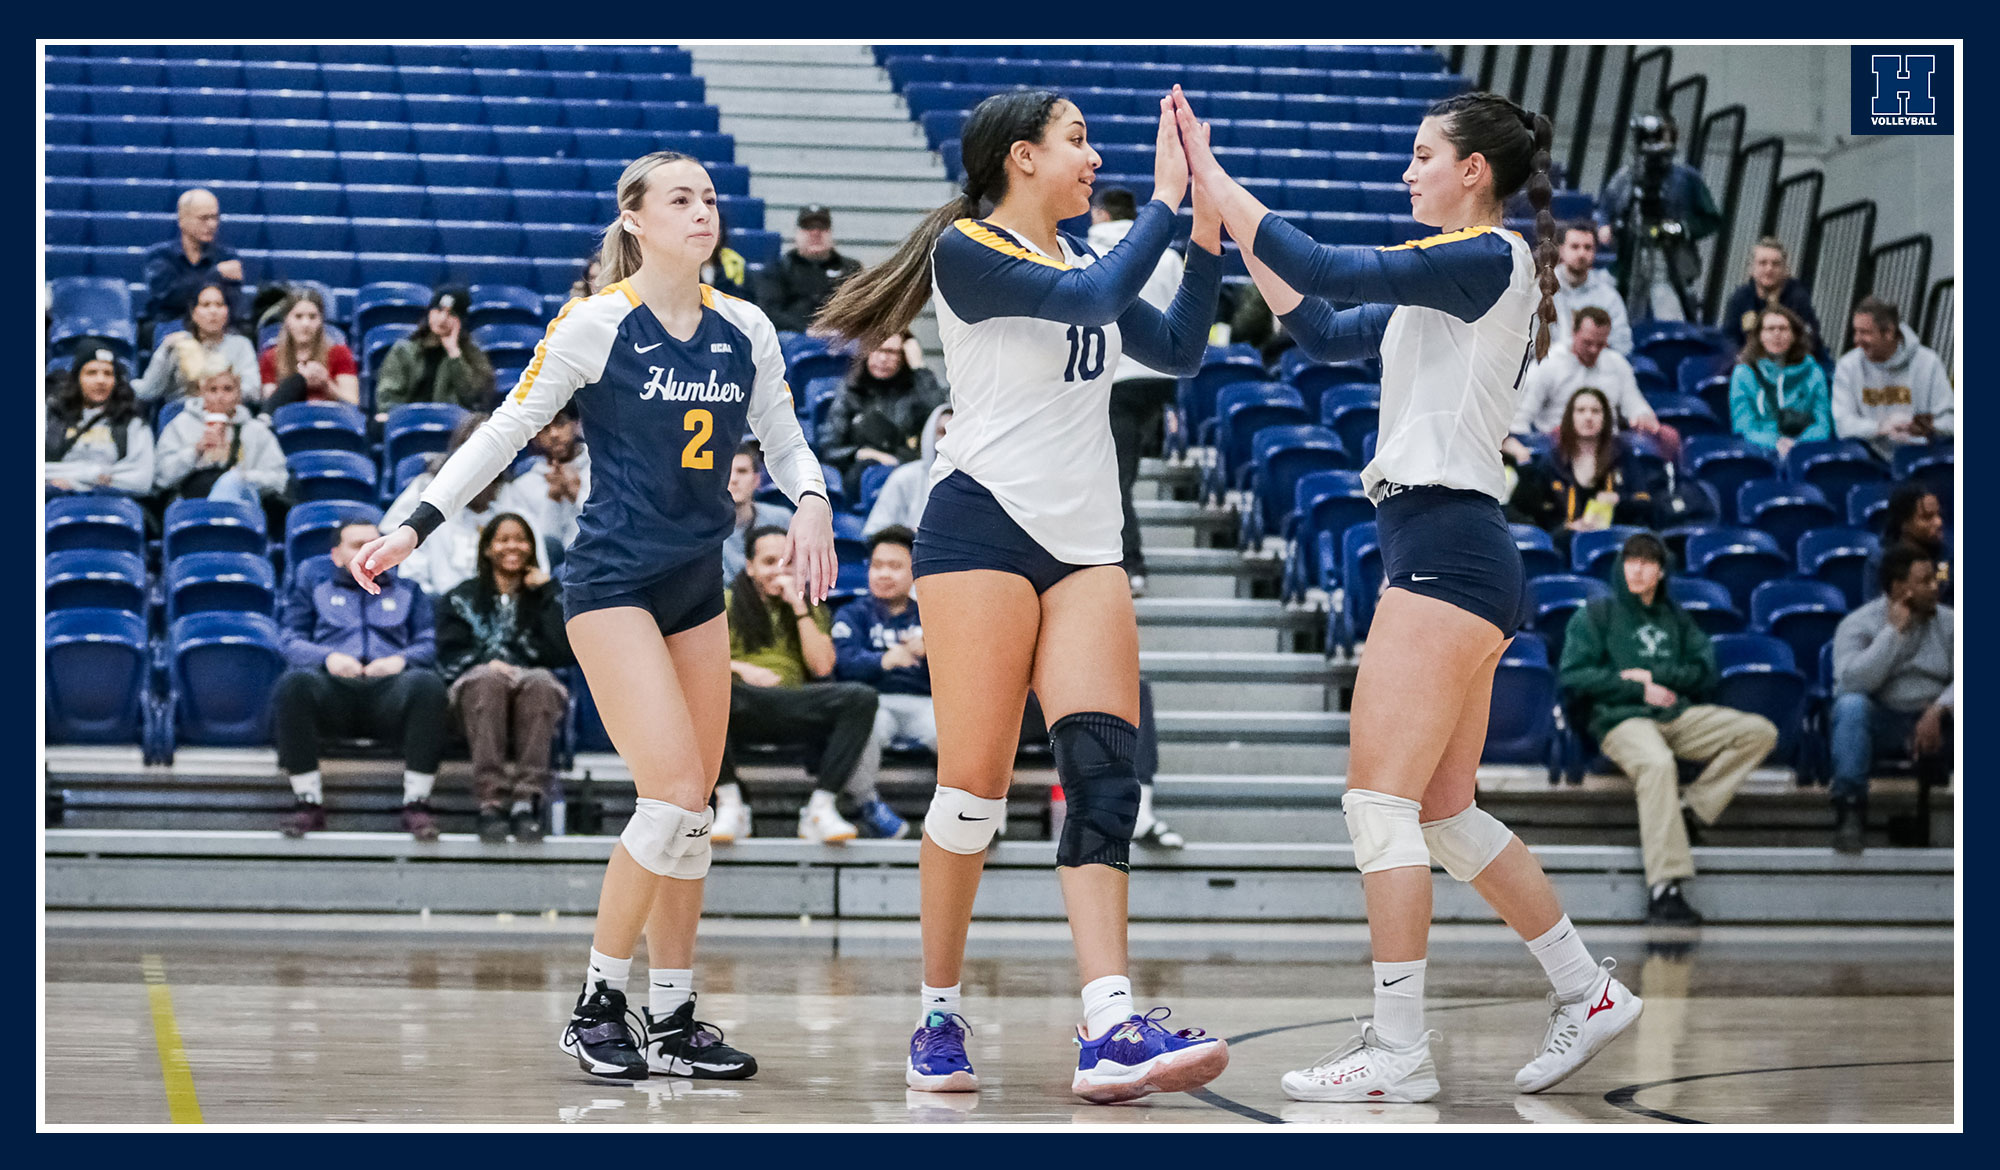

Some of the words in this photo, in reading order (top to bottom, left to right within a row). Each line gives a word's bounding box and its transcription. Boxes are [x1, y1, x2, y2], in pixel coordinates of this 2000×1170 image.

[1064, 325, 1106, 382] 10
[639, 365, 745, 403] Humber
[681, 408, 714, 470] 2
